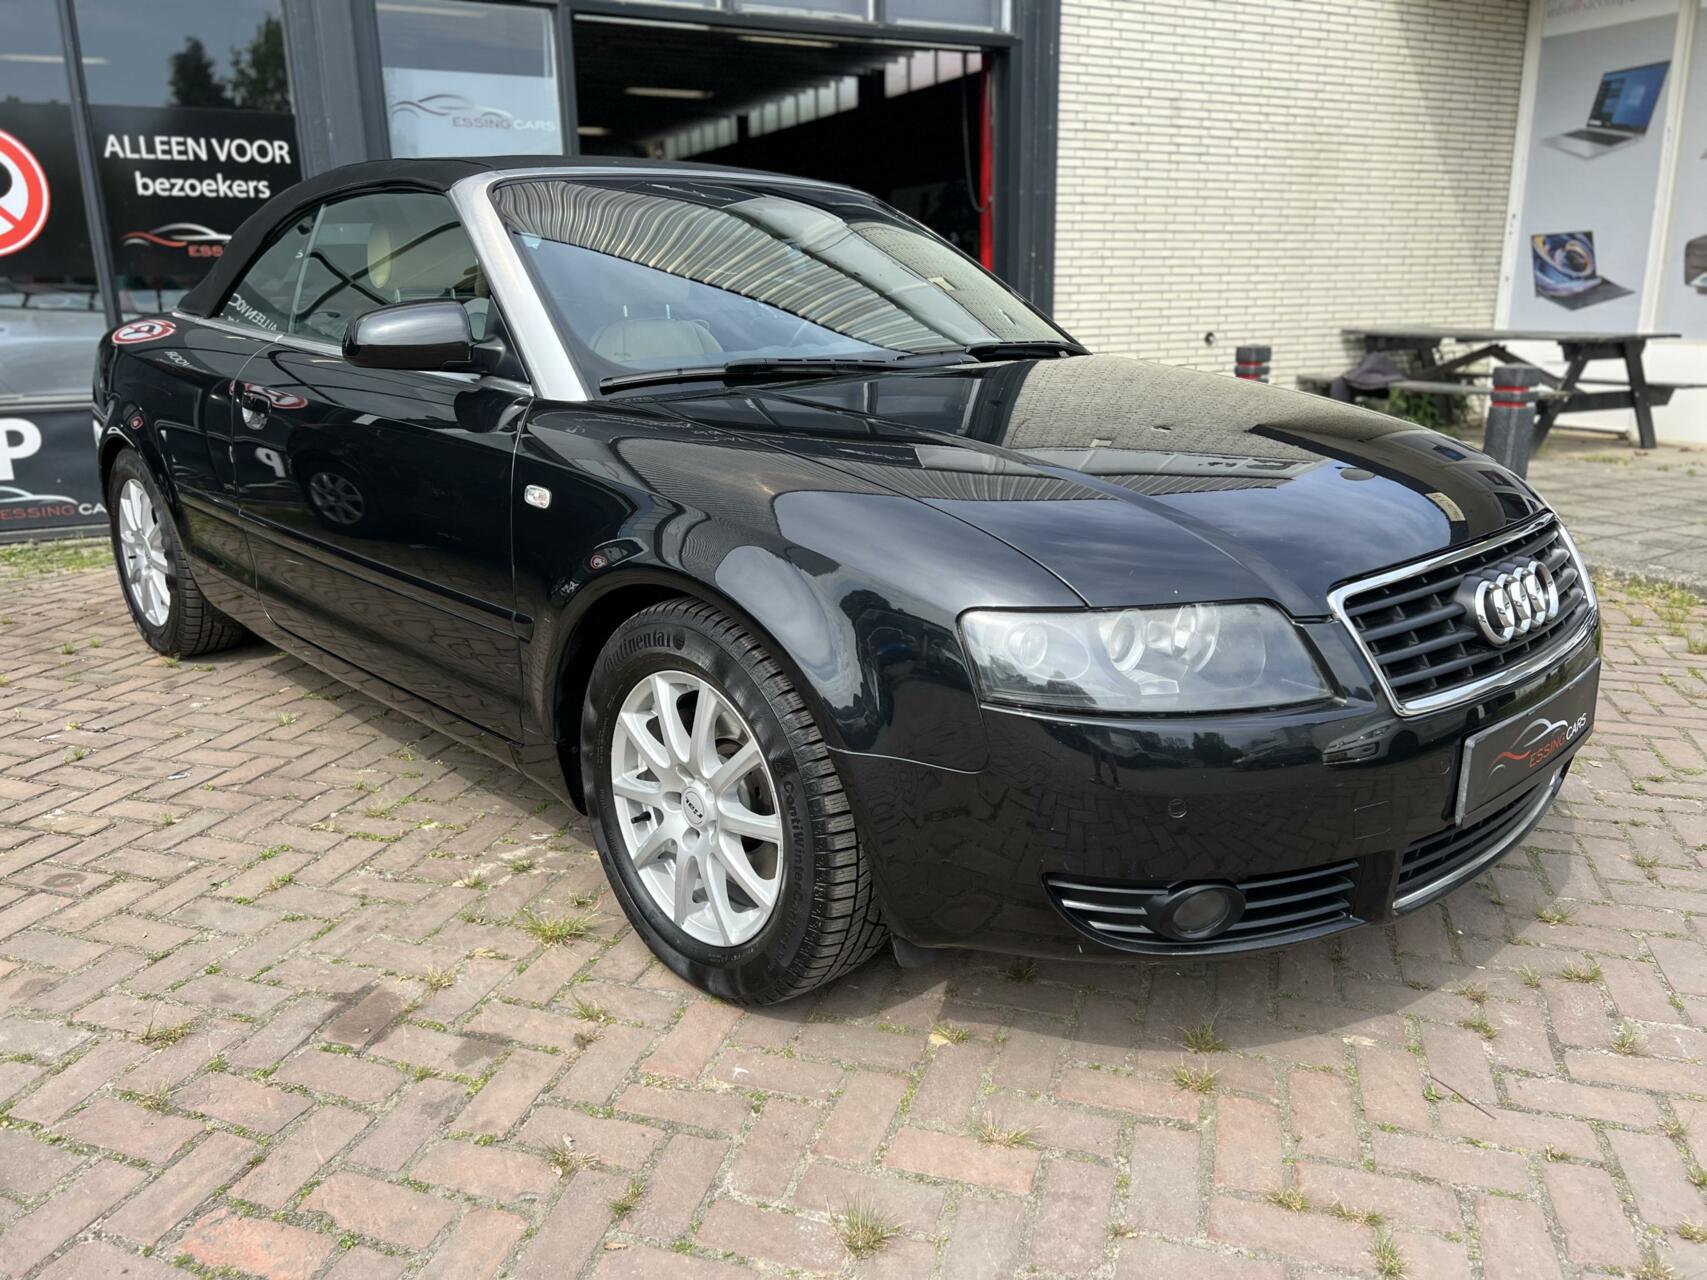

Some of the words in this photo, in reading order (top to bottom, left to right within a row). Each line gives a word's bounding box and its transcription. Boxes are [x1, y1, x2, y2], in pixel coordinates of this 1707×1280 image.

[452, 116, 512, 129] ESSING
[104, 134, 208, 161] ALLEEN
[210, 137, 291, 164] VOOR
[134, 170, 271, 199] bezoekers
[0, 417, 42, 481] P
[0, 504, 76, 520] ESSING
[78, 503, 107, 515] CA
[1529, 732, 1567, 768] ESSING
[1566, 712, 1587, 740] CARS
